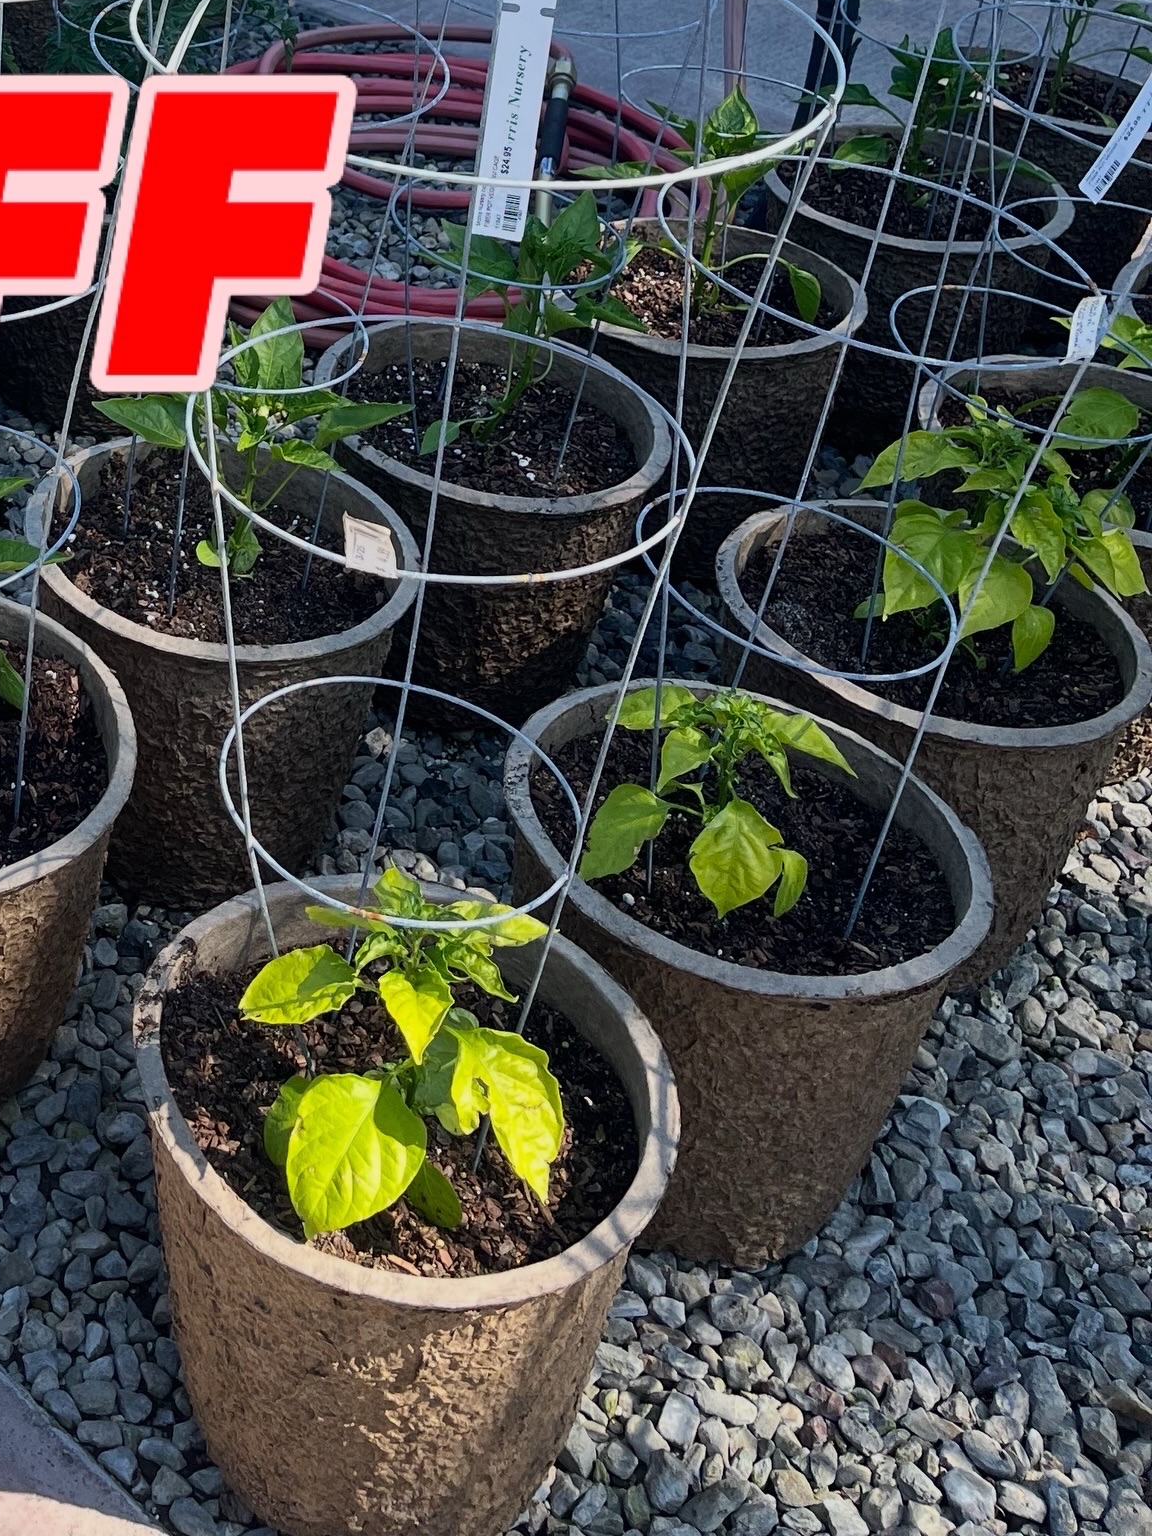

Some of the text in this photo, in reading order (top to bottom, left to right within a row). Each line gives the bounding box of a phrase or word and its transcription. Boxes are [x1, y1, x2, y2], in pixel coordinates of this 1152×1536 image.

[506, 44, 532, 145] rris Nursery
[500, 145, 512, 175] $24.95
